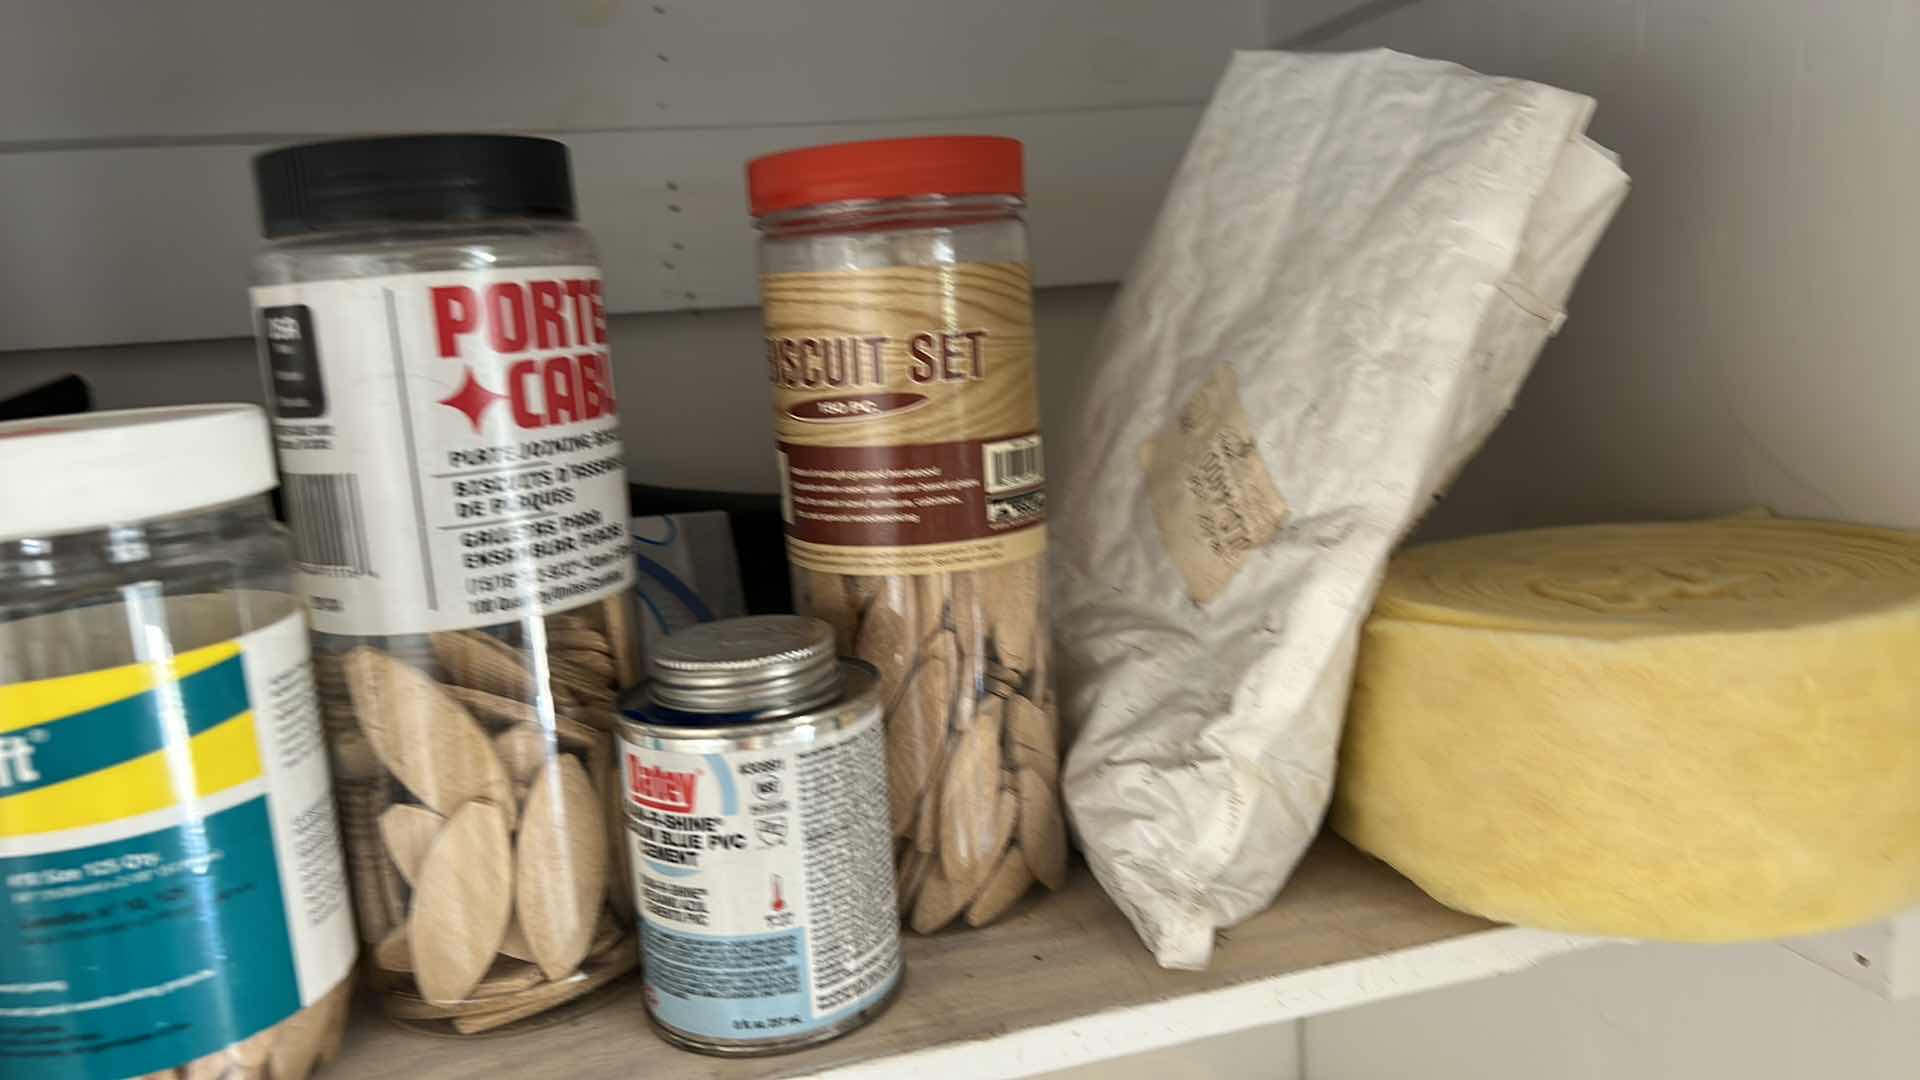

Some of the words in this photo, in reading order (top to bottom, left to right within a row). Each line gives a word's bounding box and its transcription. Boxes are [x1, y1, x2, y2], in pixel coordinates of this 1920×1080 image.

[909, 329, 990, 385] SET
[456, 501, 487, 519] DE
[661, 829, 702, 850] BLUE
[707, 832, 747, 850] PVC
